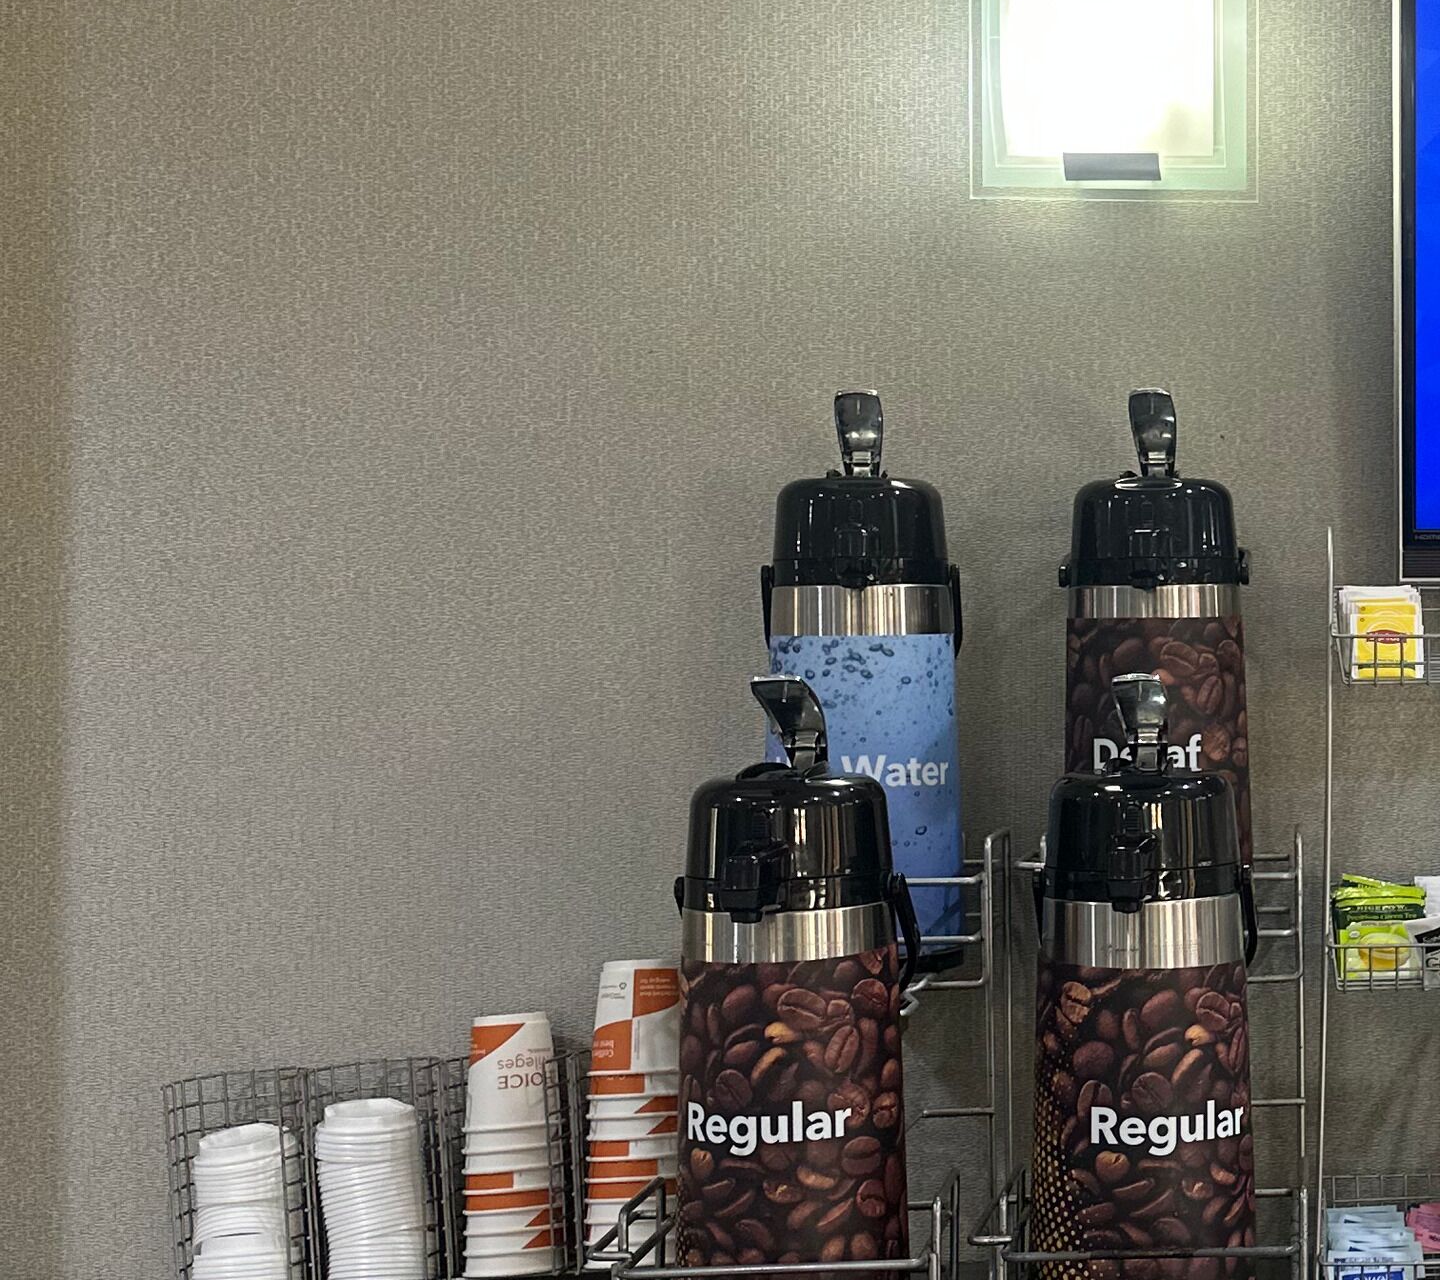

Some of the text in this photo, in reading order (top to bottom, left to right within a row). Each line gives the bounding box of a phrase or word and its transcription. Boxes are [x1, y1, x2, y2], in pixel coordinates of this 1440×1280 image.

[840, 754, 948, 787] Water
[1093, 733, 1202, 775] Deaf
[688, 1101, 852, 1156] Regular
[1091, 1099, 1244, 1156] Regular
